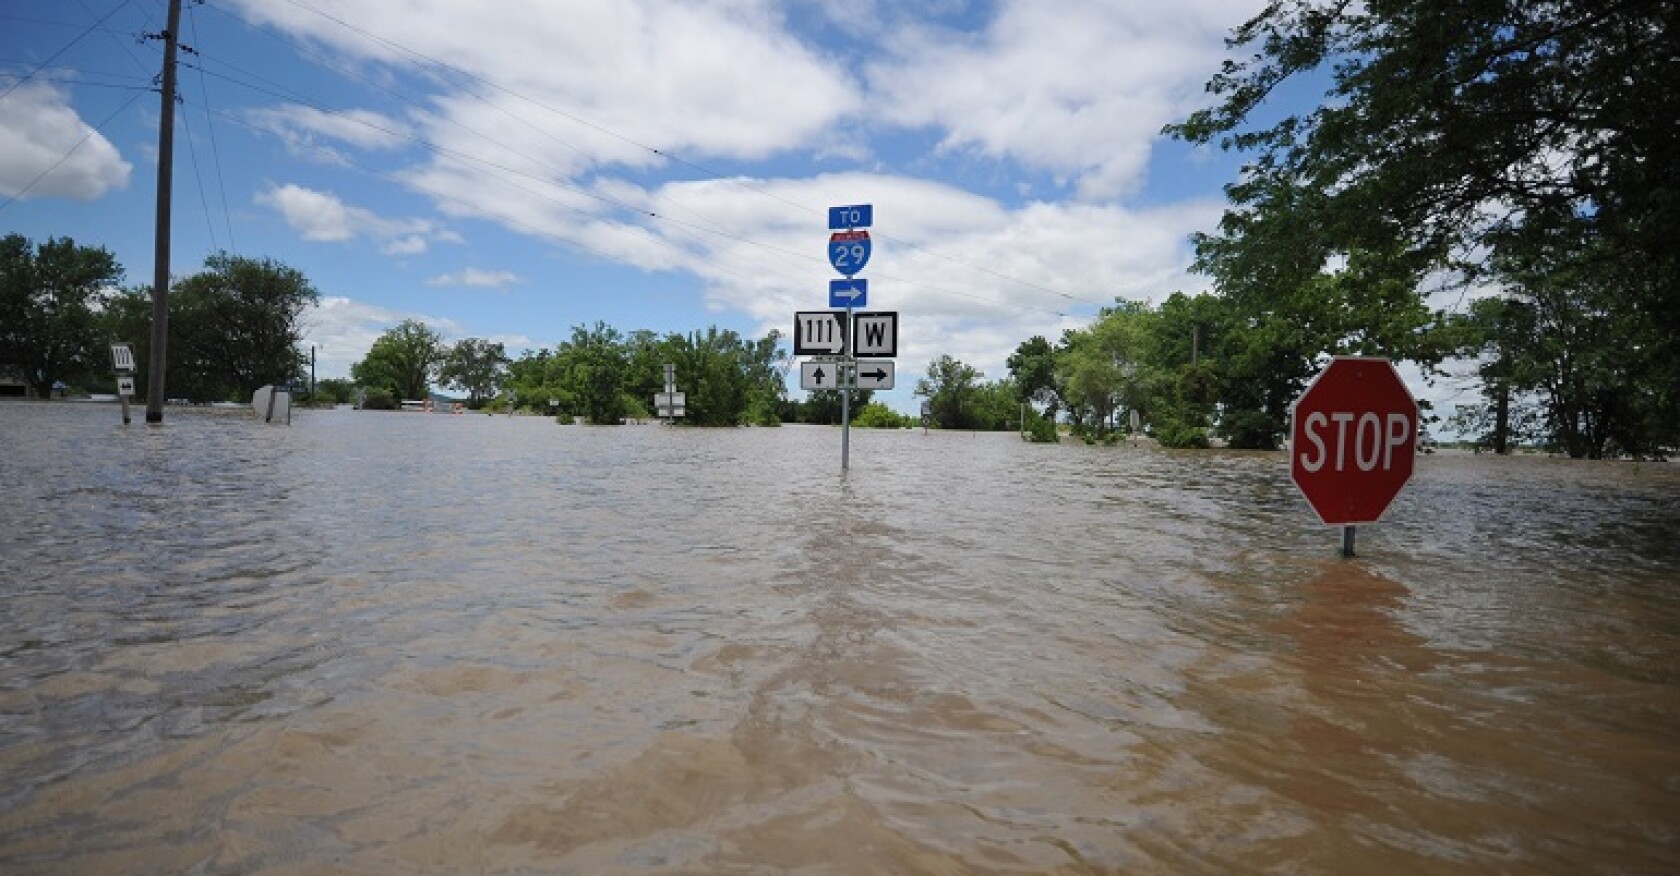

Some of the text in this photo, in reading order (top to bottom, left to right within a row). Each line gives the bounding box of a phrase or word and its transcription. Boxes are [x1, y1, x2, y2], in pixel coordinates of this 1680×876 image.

[840, 210, 861, 224] TO
[835, 245, 865, 267] 29
[806, 319, 833, 343] 111
[865, 321, 886, 347] W
[1299, 411, 1411, 473] STOP
